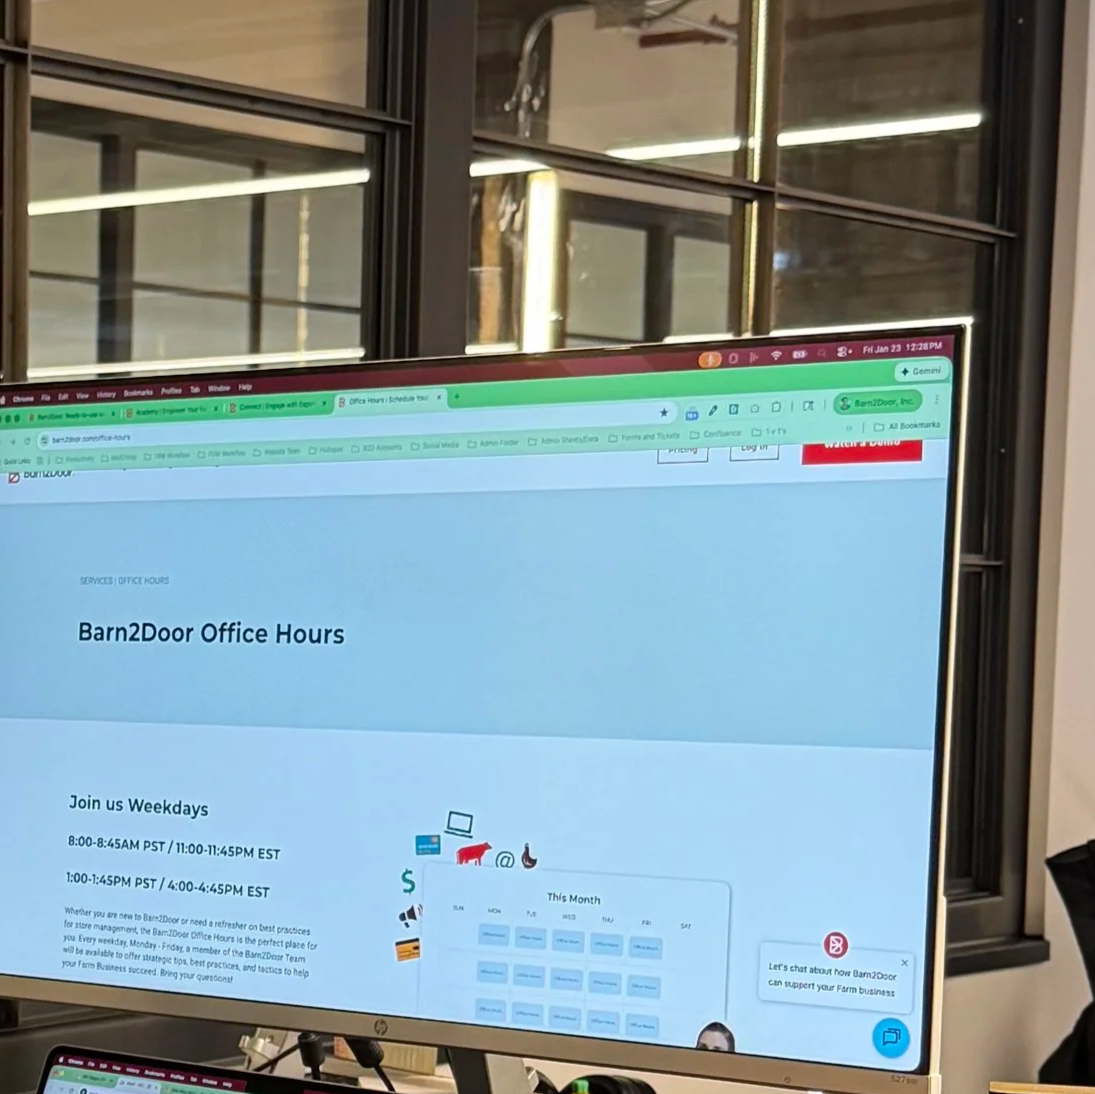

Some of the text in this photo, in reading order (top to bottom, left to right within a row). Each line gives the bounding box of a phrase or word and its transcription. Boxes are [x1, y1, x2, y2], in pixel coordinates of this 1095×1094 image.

[863, 345, 872, 354] Fri
[874, 345, 889, 353] Jan
[891, 344, 901, 352] 23
[913, 366, 941, 375] Gemini
[80, 576, 169, 585] SERVICES OFFICE HOURS
[78, 621, 345, 644] Barn2Door Office Hours
[69, 795, 209, 819] Join us Weekdays
[68, 836, 140, 851] 8:00-8:45AM
[143, 840, 166, 852] PST
[176, 842, 254, 858] 11:00-11:45PM
[258, 849, 281, 860] EST
[66, 872, 131, 887] 1:00-1:45PM
[135, 877, 157, 889] PST
[167, 880, 243, 896] 4:00-4:45PM
[247, 886, 270, 898] EST
[547, 893, 601, 905] This Month
[65, 907, 92, 916] Whether
[143, 914, 179, 923] Barn2Door
[215, 920, 247, 930] refresher
[259, 924, 275, 932] best
[277, 926, 310, 935] practices
[64, 920, 73, 928] for
[93, 924, 138, 934] management,
[140, 926, 151, 935] the
[152, 927, 189, 938] Barn2Door
[191, 932, 212, 940] Office
[214, 934, 235, 943] Hours
[244, 936, 256, 944] the
[257, 938, 283, 947] perfect
[285, 940, 305, 949] place
[307, 942, 318, 950] for
[78, 934, 96, 944] Every
[130, 940, 156, 951] Monday
[192, 946, 221, 955] member
[222, 948, 230, 956] of
[245, 950, 284, 961] Barn2Door
[285, 953, 306, 963] Team
[62, 960, 76, 968] your
[78, 960, 95, 968] Farm
[97, 962, 126, 973] Business
[160, 968, 178, 980] Bring
[180, 972, 195, 980] your
[76, 946, 83, 955] be
[85, 949, 114, 958] available
[116, 951, 123, 959] to
[124, 952, 141, 960] offer
[143, 954, 172, 964] strategic
[190, 959, 205, 967] best
[207, 961, 241, 972] practices,
[243, 964, 256, 972] and
[258, 965, 282, 974] tactics
[284, 968, 292, 976] to
[293, 968, 309, 979] help
[768, 962, 897, 981] Let's chat about how Barn2Door
[768, 979, 895, 998] can support your Farm business
